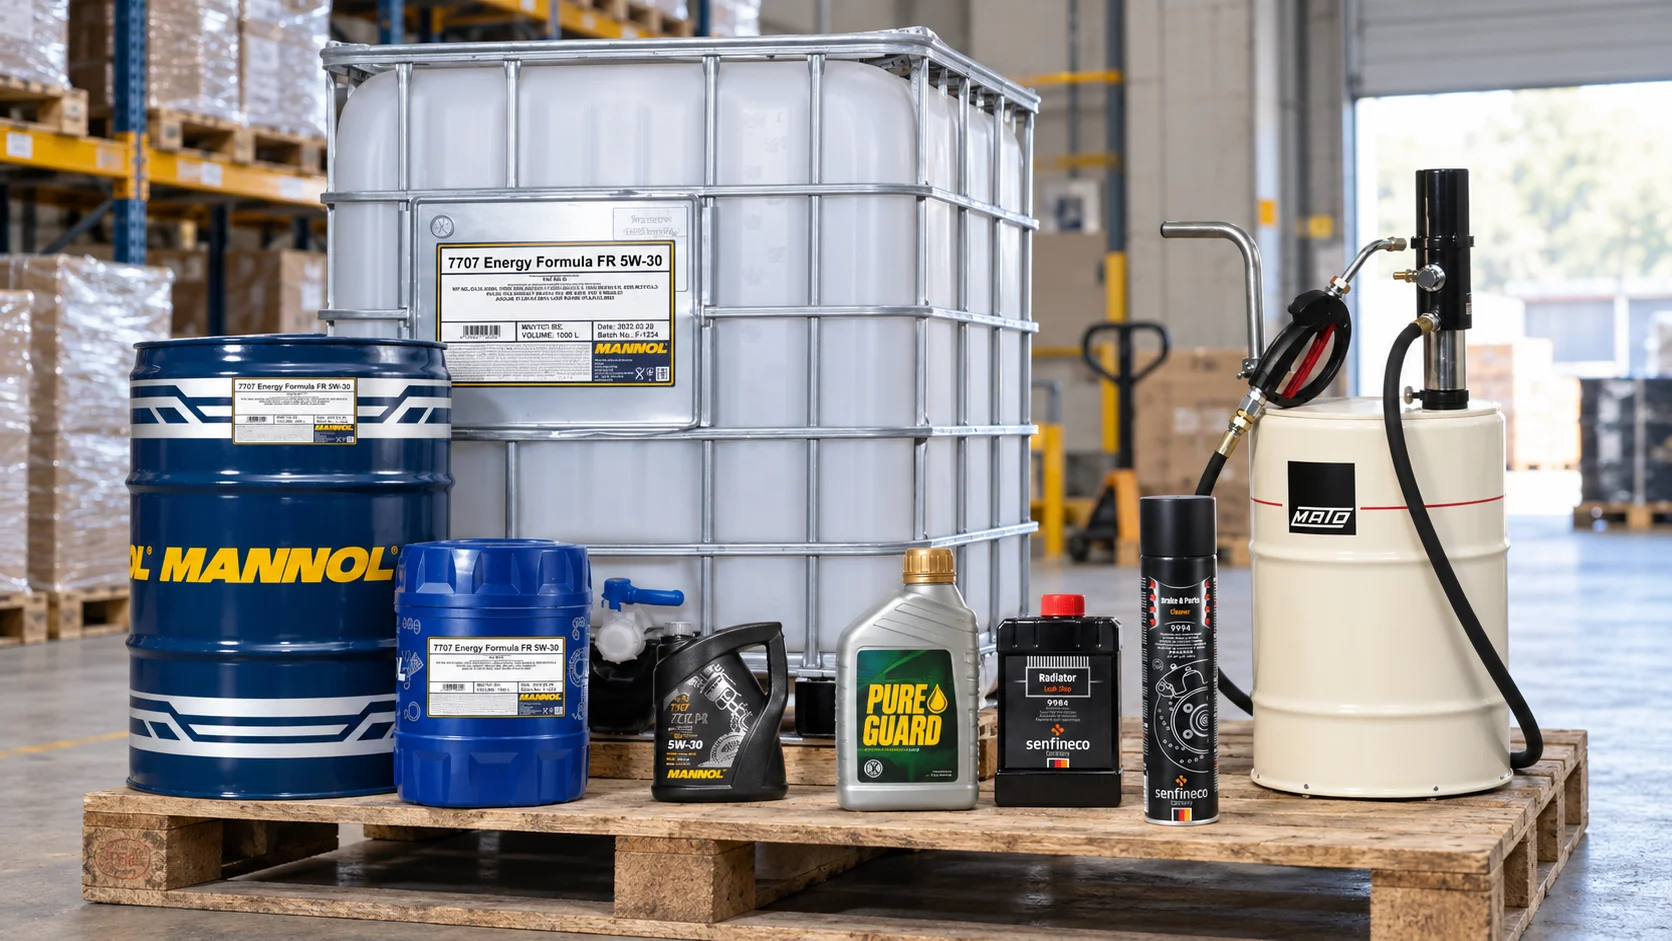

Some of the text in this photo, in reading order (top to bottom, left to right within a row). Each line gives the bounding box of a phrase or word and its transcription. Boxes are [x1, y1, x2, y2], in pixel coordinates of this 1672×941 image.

[448, 254, 663, 271] 7707 Energy Formula FR 5W-30
[594, 342, 668, 355] MANNOL
[257, 382, 284, 391] Energy
[1290, 506, 1354, 528] MATO
[159, 546, 395, 584] MANNOL
[434, 644, 453, 652] 7707
[454, 644, 482, 654] Energy
[485, 644, 519, 652] Formula
[520, 644, 533, 652] FR
[1038, 673, 1077, 682] Radiator
[866, 683, 928, 714] PURE
[862, 715, 942, 746] GUARD
[667, 740, 704, 750] 5W-30
[1026, 737, 1090, 750] senfineco
[667, 769, 724, 780] MANNOL
[1154, 787, 1208, 800] senfineco
